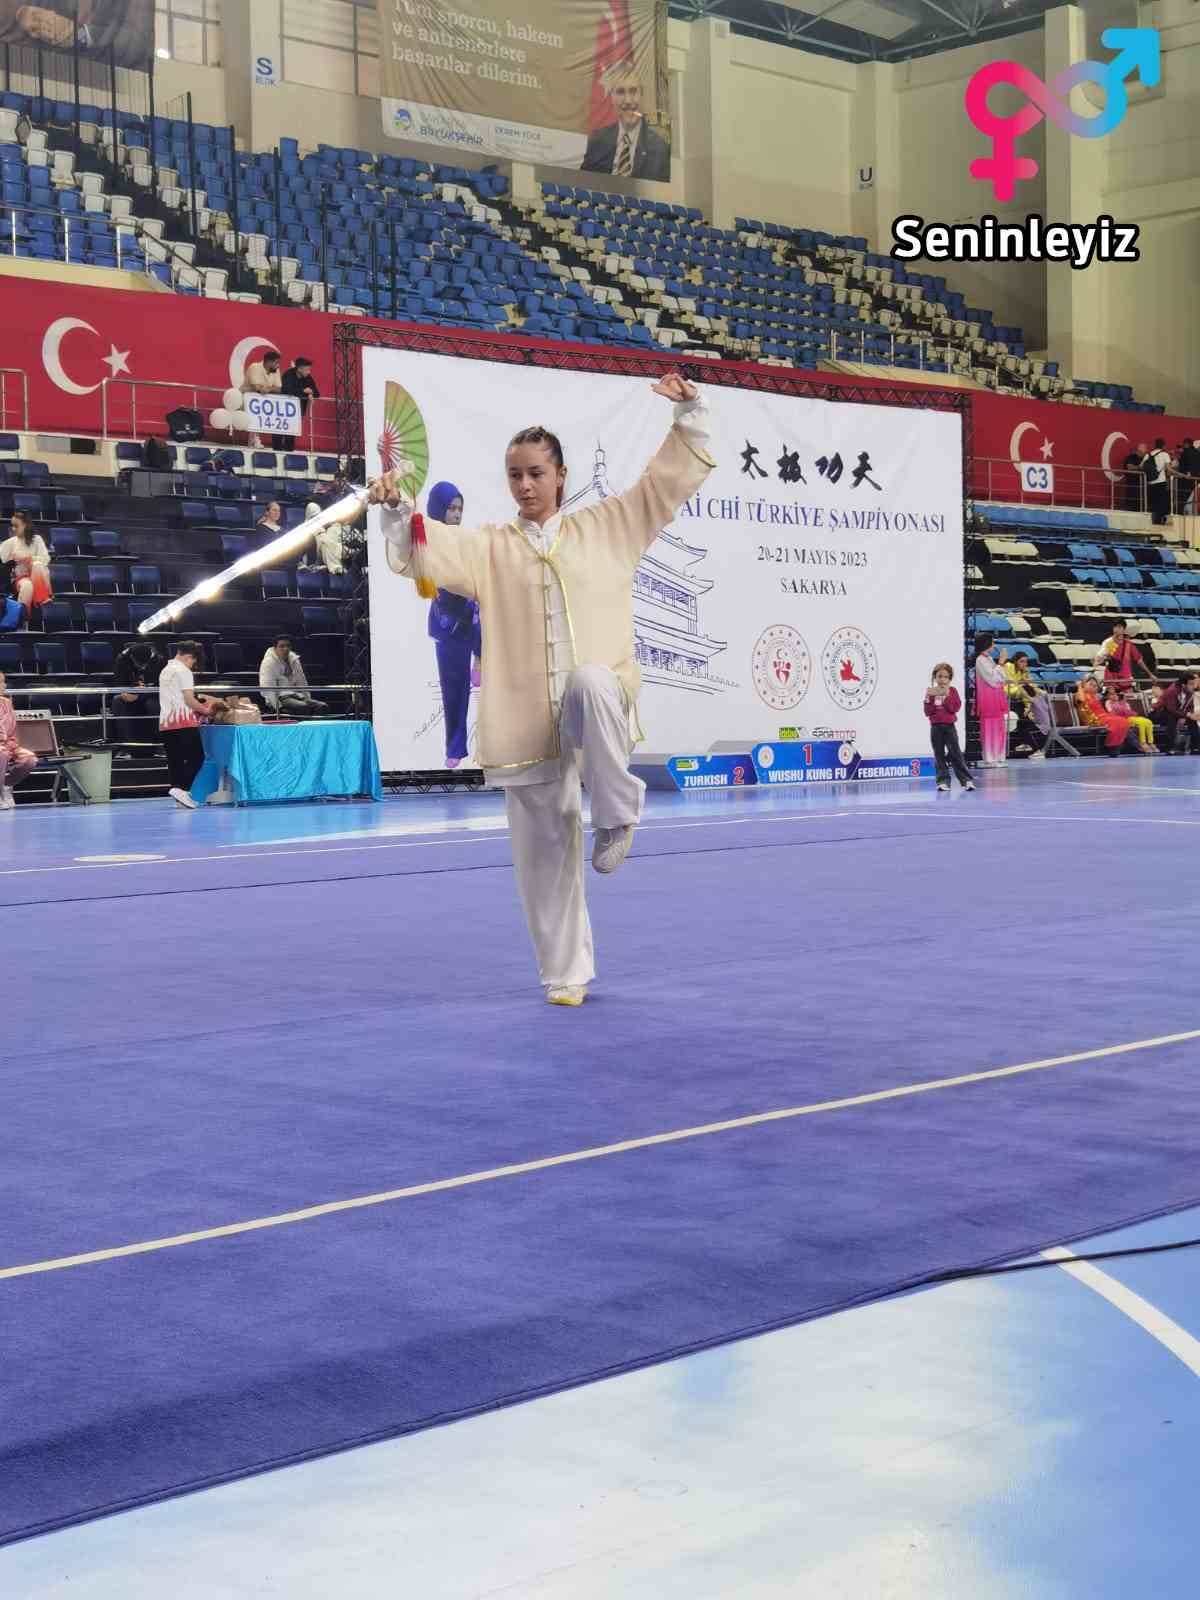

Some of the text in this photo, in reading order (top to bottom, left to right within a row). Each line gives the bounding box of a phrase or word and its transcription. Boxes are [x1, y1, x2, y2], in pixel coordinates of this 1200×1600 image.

[392, 21, 414, 38] ve
[505, 20, 564, 48] hakem
[256, 57, 273, 76] S
[860, 166, 873, 183] U
[249, 398, 297, 417] GOLD
[257, 416, 289, 430] 14-26
[1026, 466, 1049, 489] C3
[680, 492, 945, 533] Aİ CHİ TÜRKİYE ŞAMPİYONASI
[757, 545, 790, 563] 20-21
[840, 551, 868, 567] 2023
[780, 577, 847, 595] SAKARYA
[802, 744, 813, 766] 1
[732, 766, 746, 785] 2
[768, 767, 847, 782] WUSHU KUNG FU
[858, 766, 910, 778] FEDERATION
[911, 759, 921, 777] 3
[684, 774, 728, 787] TURKISH
